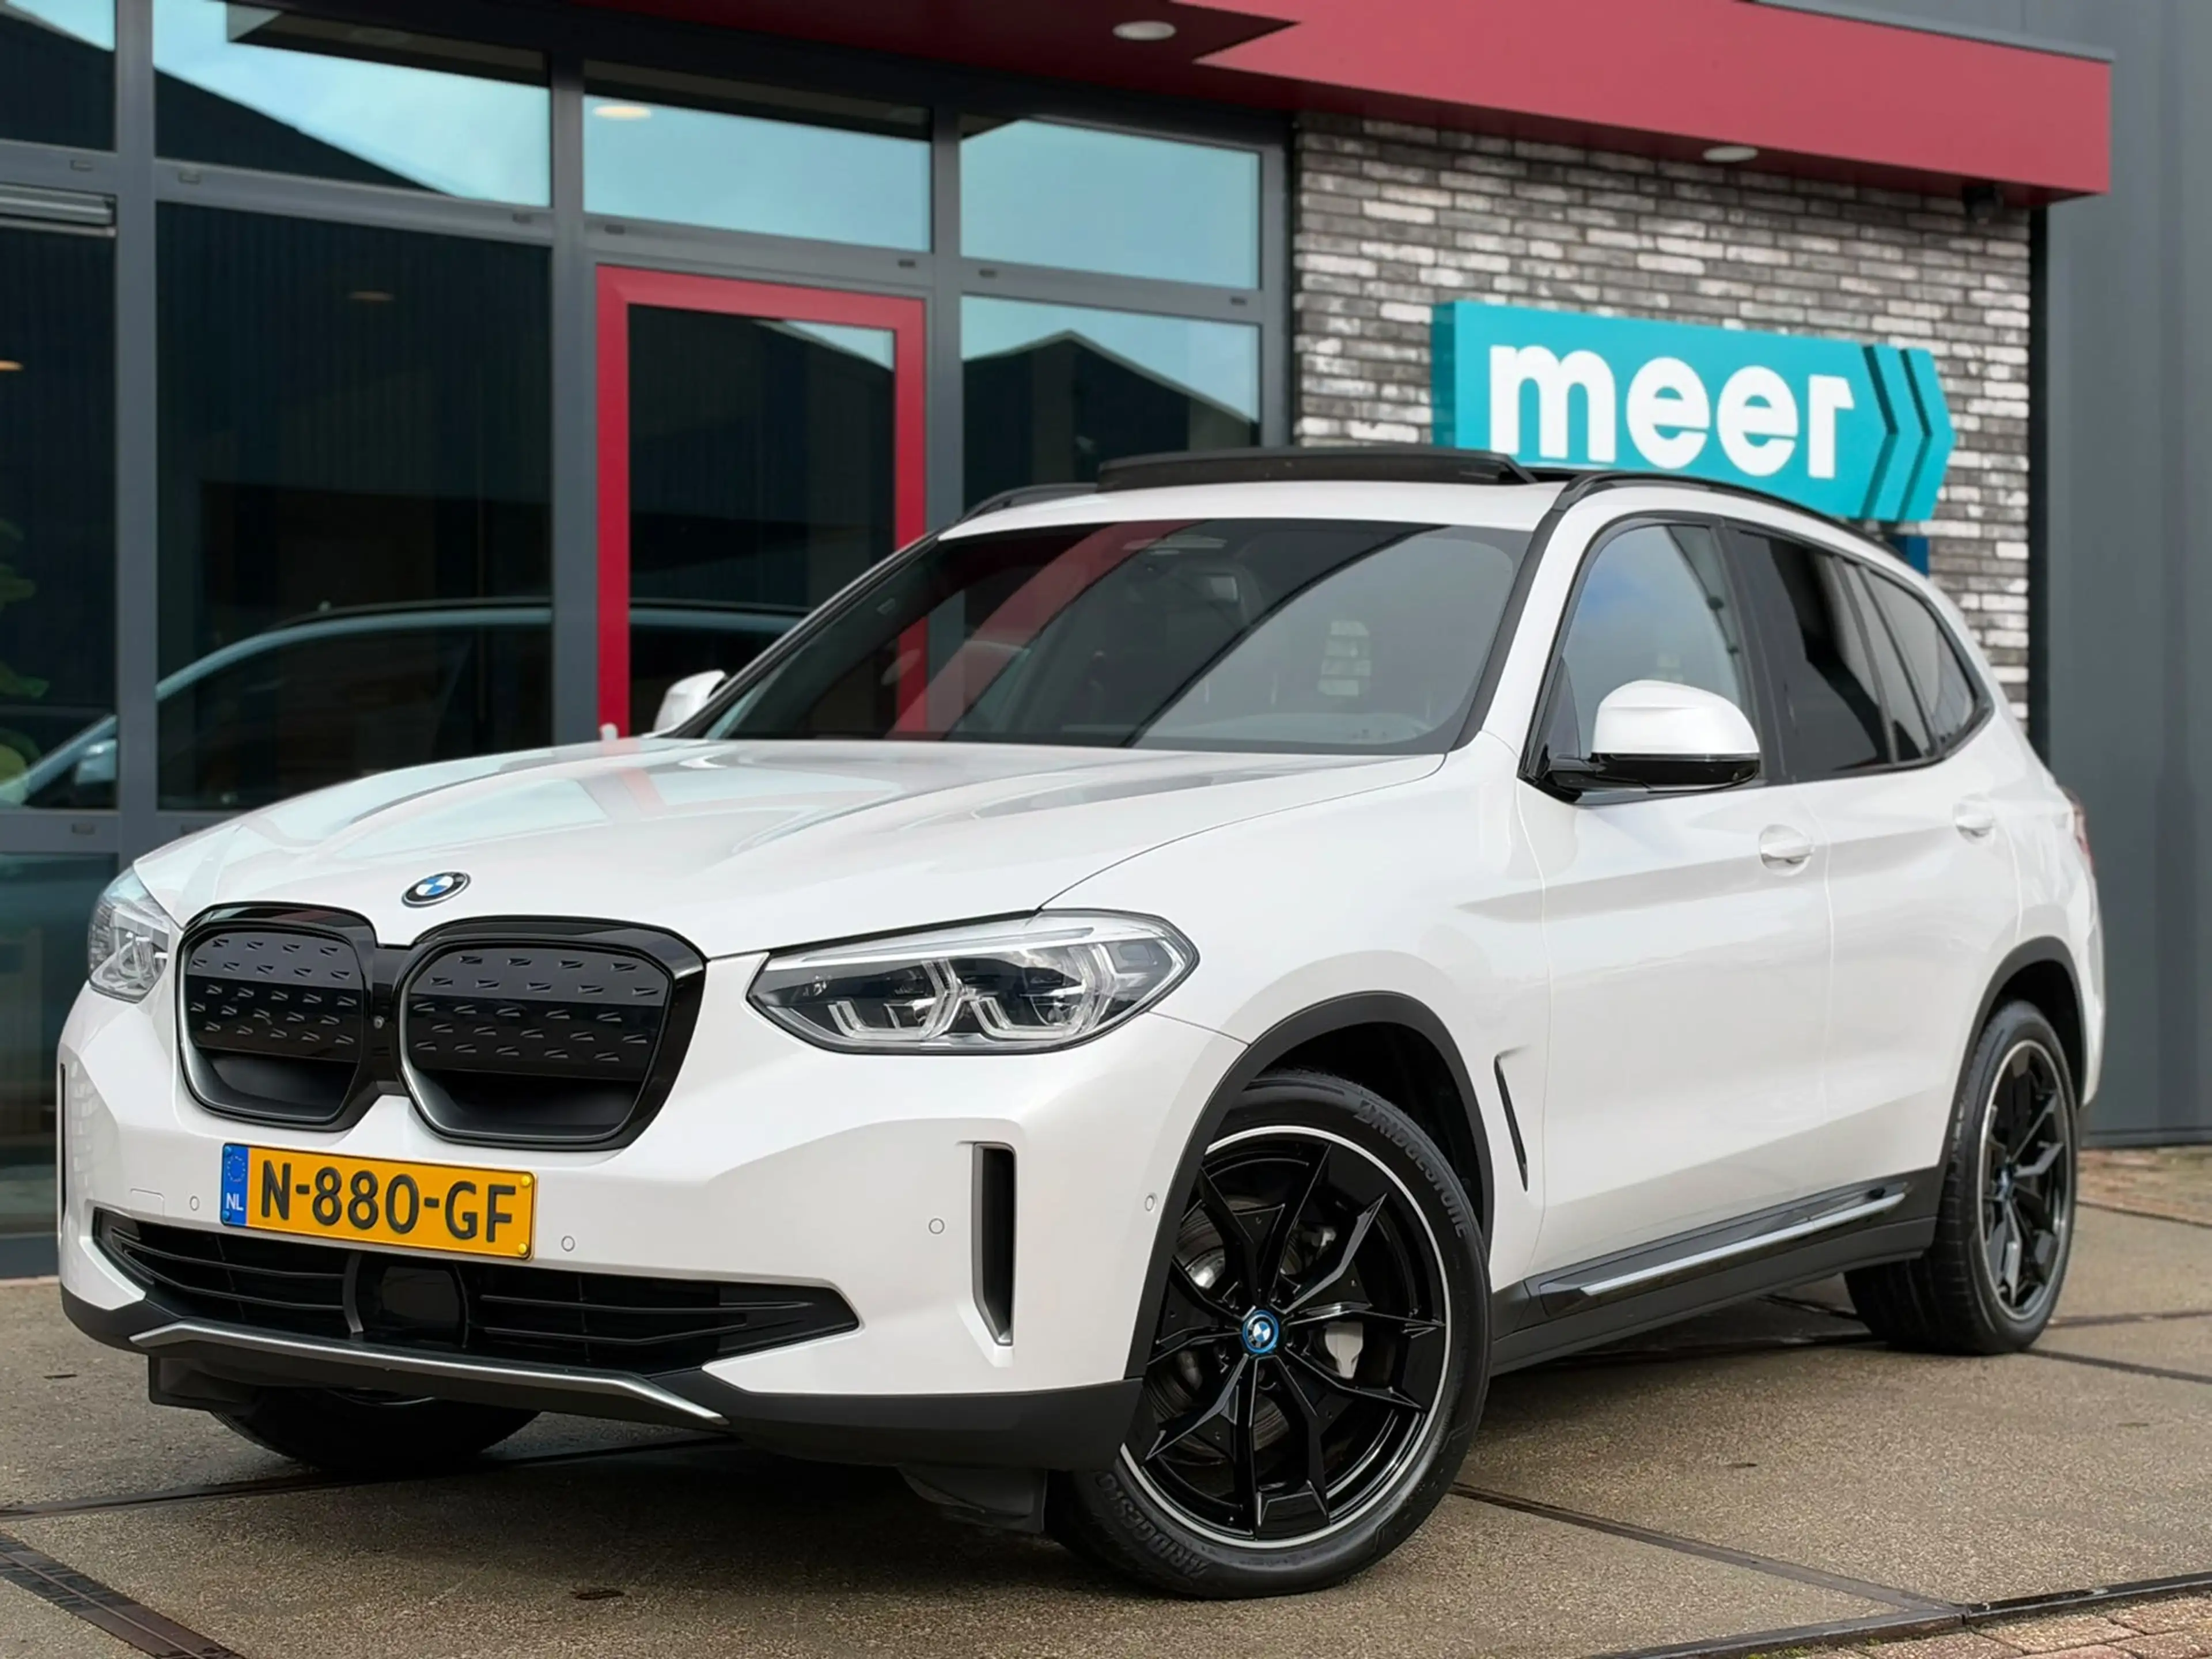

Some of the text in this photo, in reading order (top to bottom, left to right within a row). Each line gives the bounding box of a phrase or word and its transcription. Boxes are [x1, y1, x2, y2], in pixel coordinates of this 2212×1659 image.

[1488, 344, 1855, 479] meer
[226, 1192, 244, 1211] NL
[261, 1159, 517, 1243] N-880-GF
